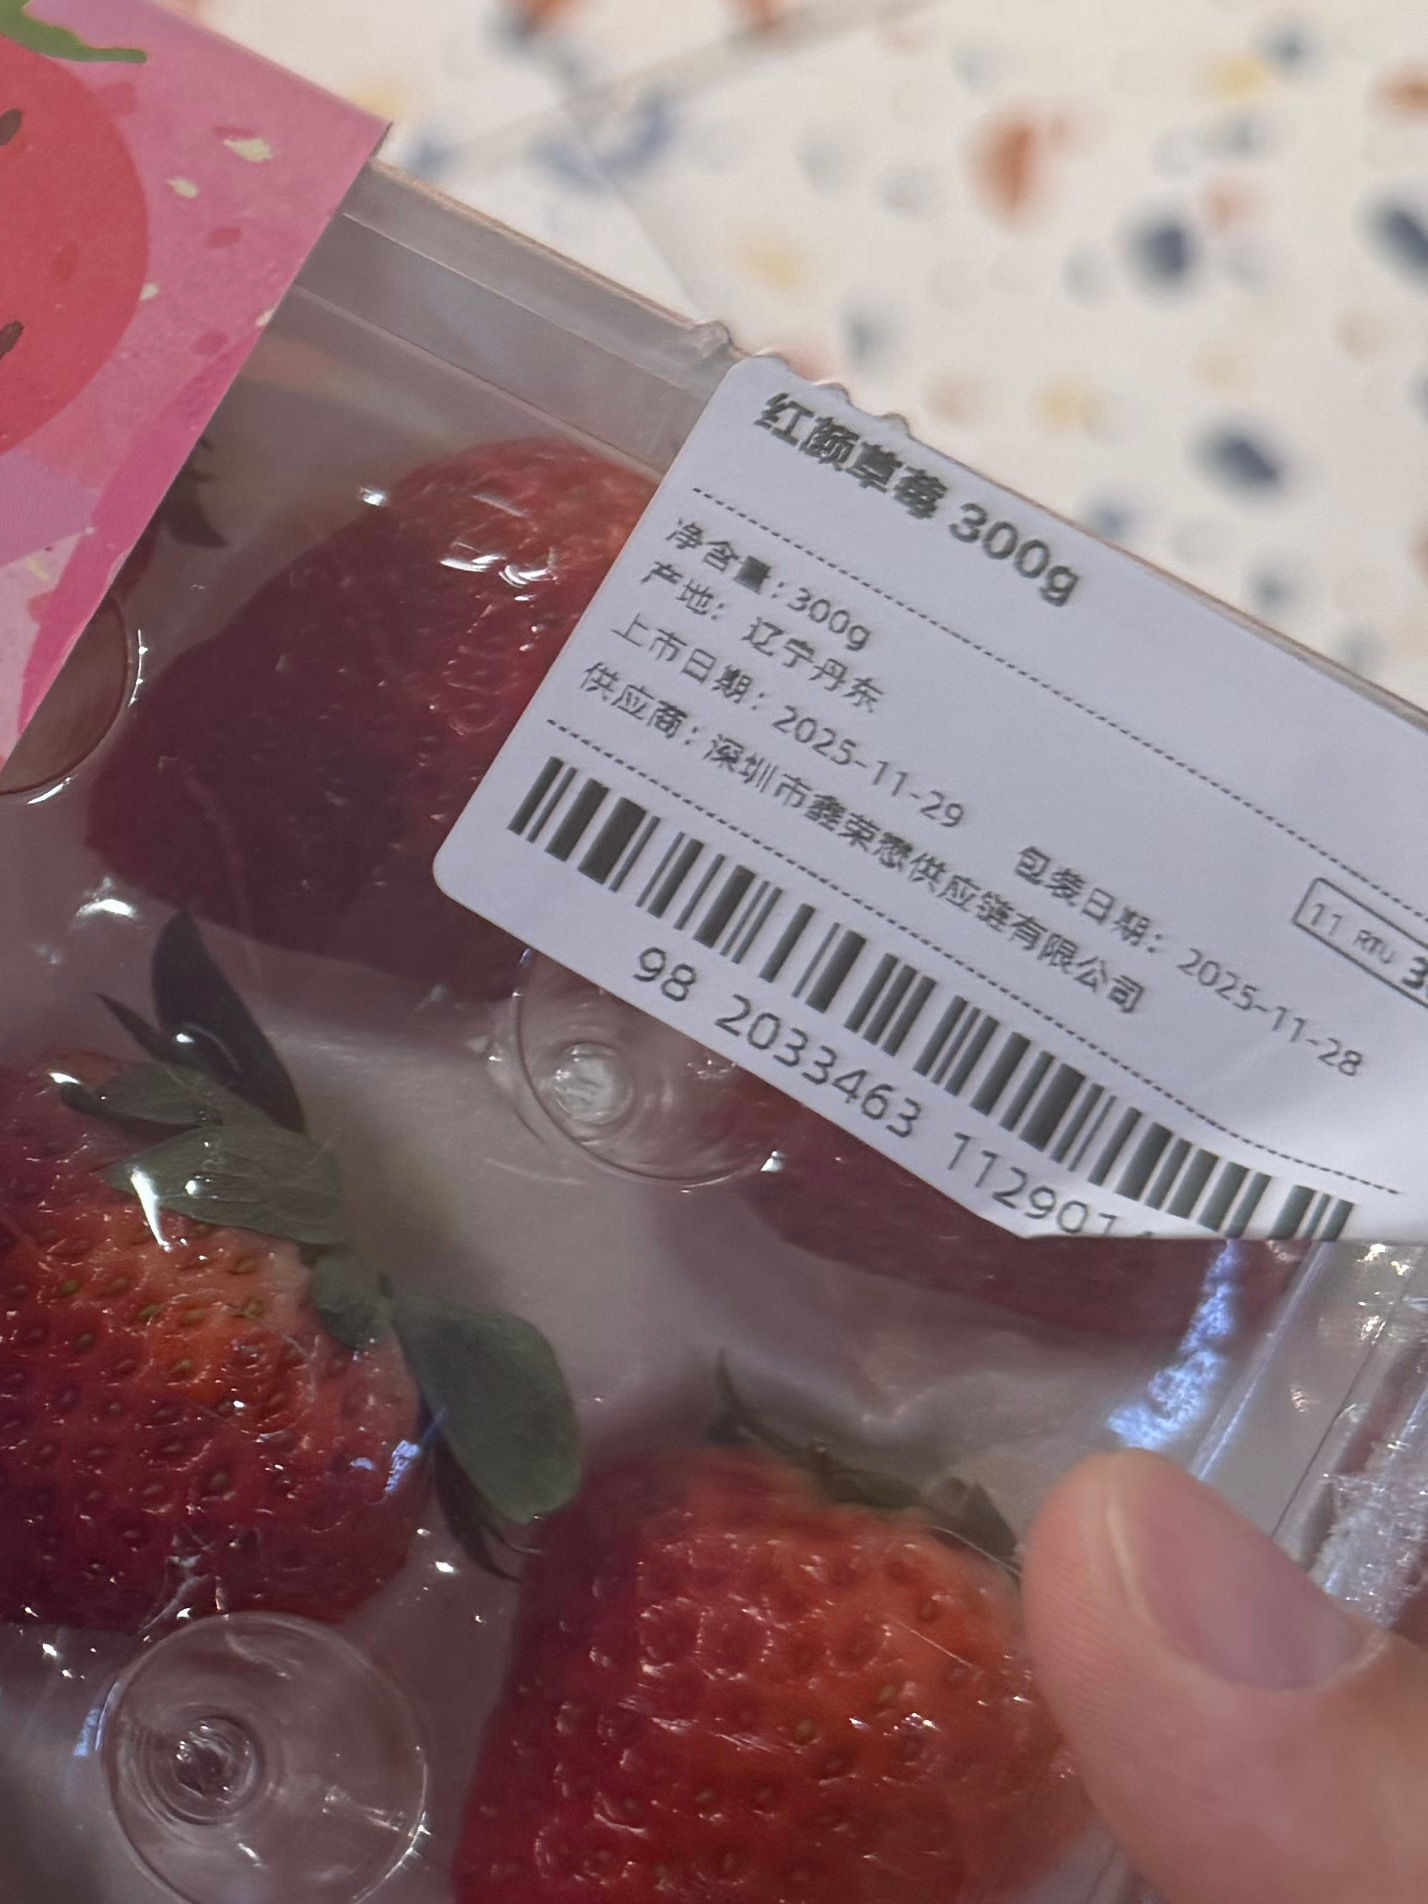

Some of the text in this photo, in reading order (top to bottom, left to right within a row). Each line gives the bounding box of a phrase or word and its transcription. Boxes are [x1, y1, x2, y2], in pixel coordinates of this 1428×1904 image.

[755, 392, 1082, 608] 红颜草莓 300g
[1401, 956, 1428, 1001] 3
[635, 945, 1153, 1237] 98 2033463 112901
